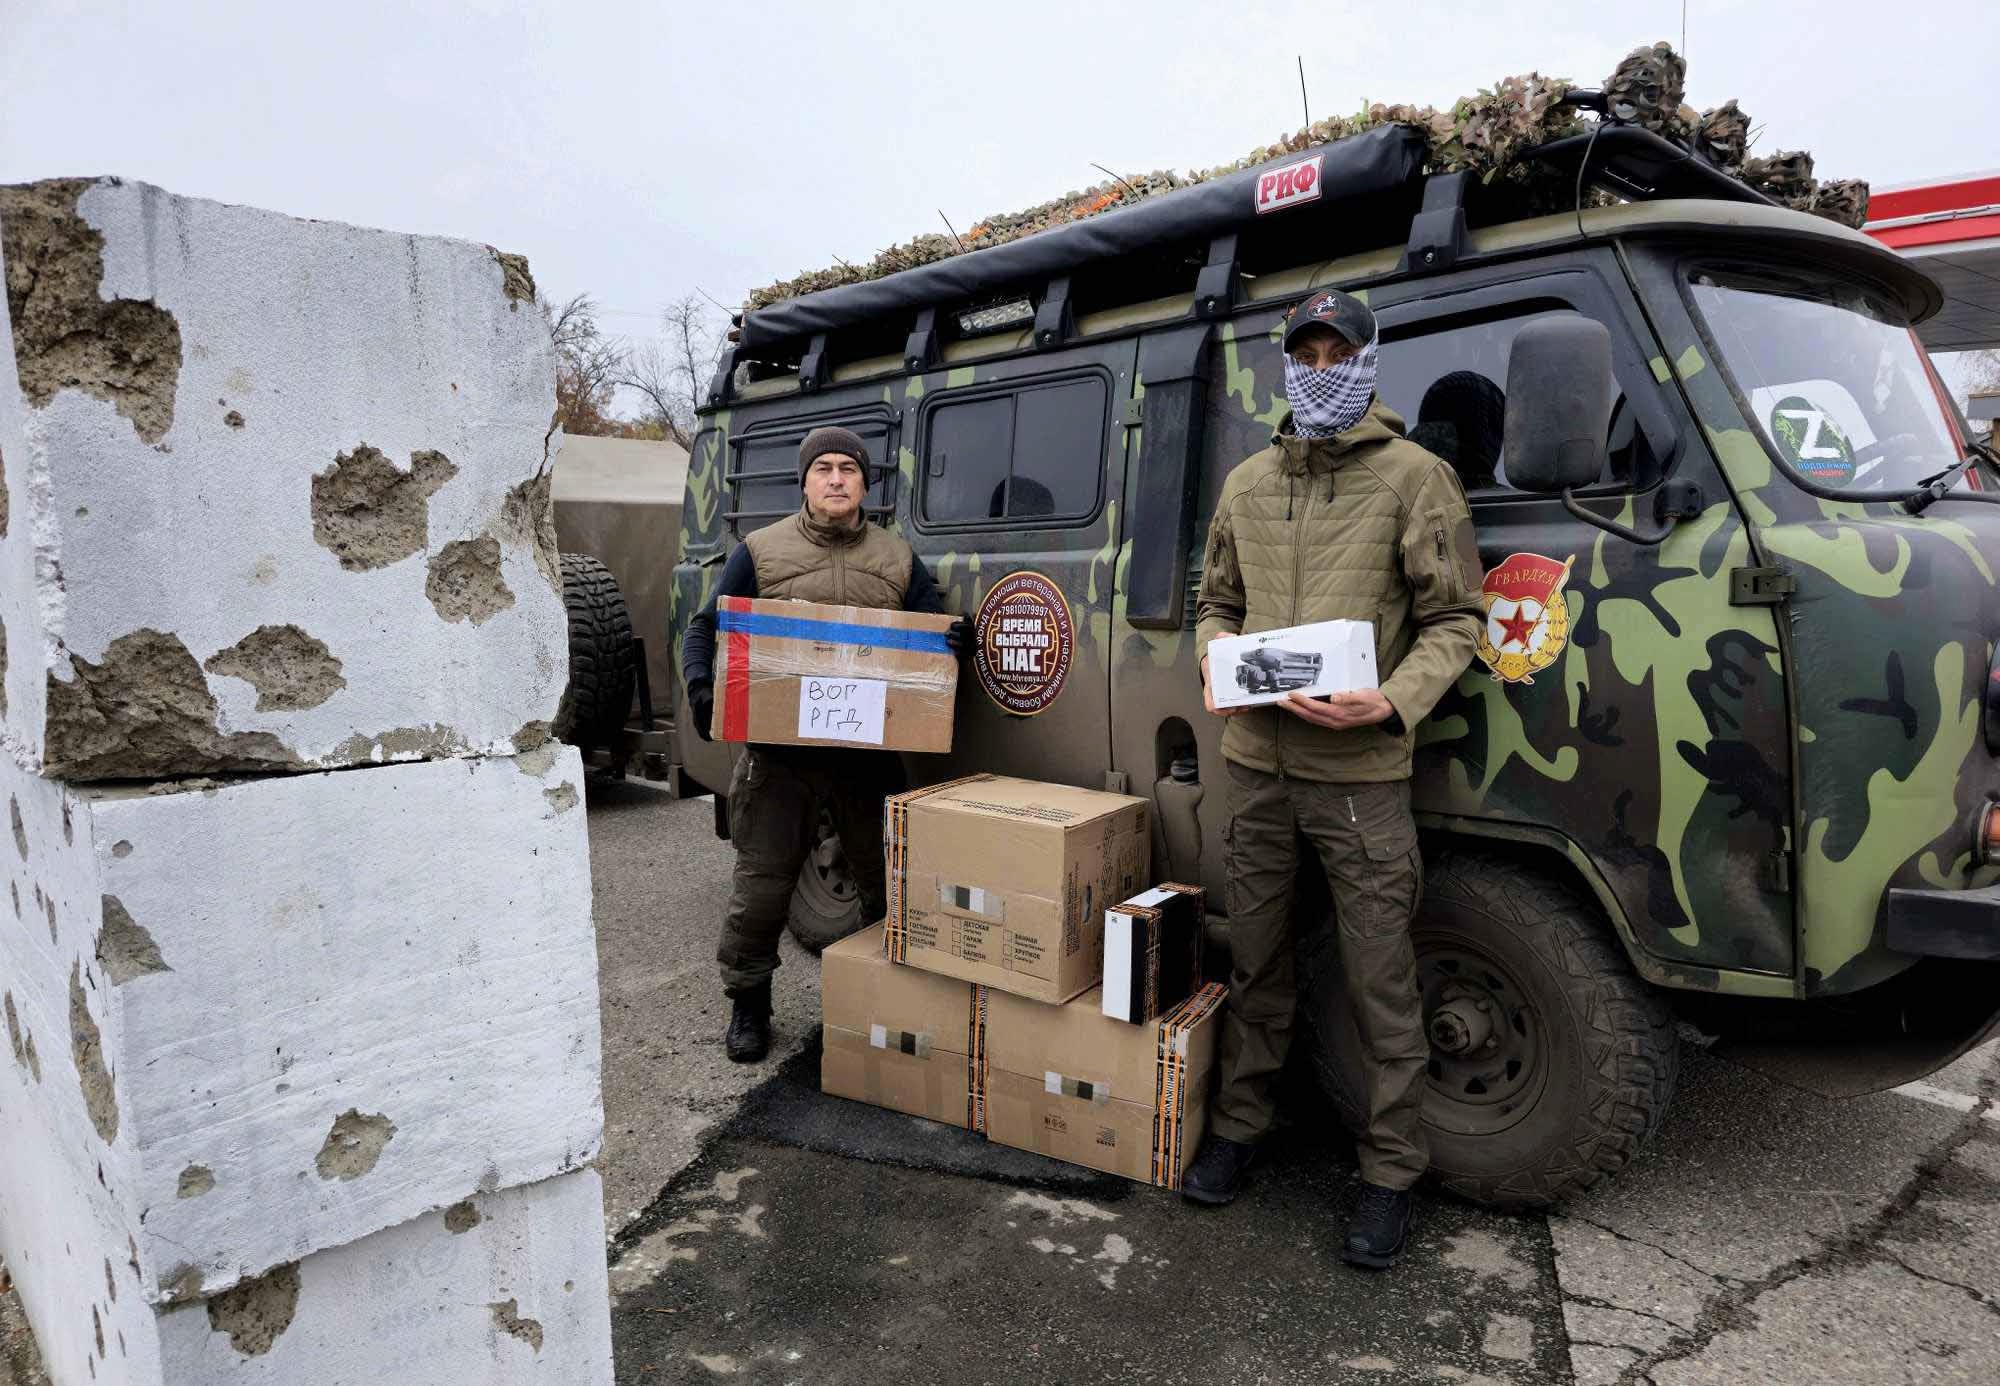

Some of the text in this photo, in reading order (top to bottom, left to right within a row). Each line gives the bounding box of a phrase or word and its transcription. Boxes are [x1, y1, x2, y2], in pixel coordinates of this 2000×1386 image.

[1260, 164, 1317, 204] РИФ
[1775, 409, 1841, 459] Z
[1494, 568, 1556, 585] ГВАРДИЯ
[985, 580, 1019, 613] помощи
[1020, 578, 1065, 617] ветеранам
[997, 604, 1049, 617] +79810079997
[1002, 619, 1042, 632] ВРЕМЯ
[1060, 621, 1068, 629] и
[995, 633, 1049, 648] ВЫБРАЛО
[1002, 647, 1041, 672] НАС
[1041, 633, 1070, 701] участникам
[976, 649, 1007, 700] действий
[809, 680, 857, 701] ВОГ
[1006, 696, 1041, 708] боевых
[811, 706, 863, 732] РГД
